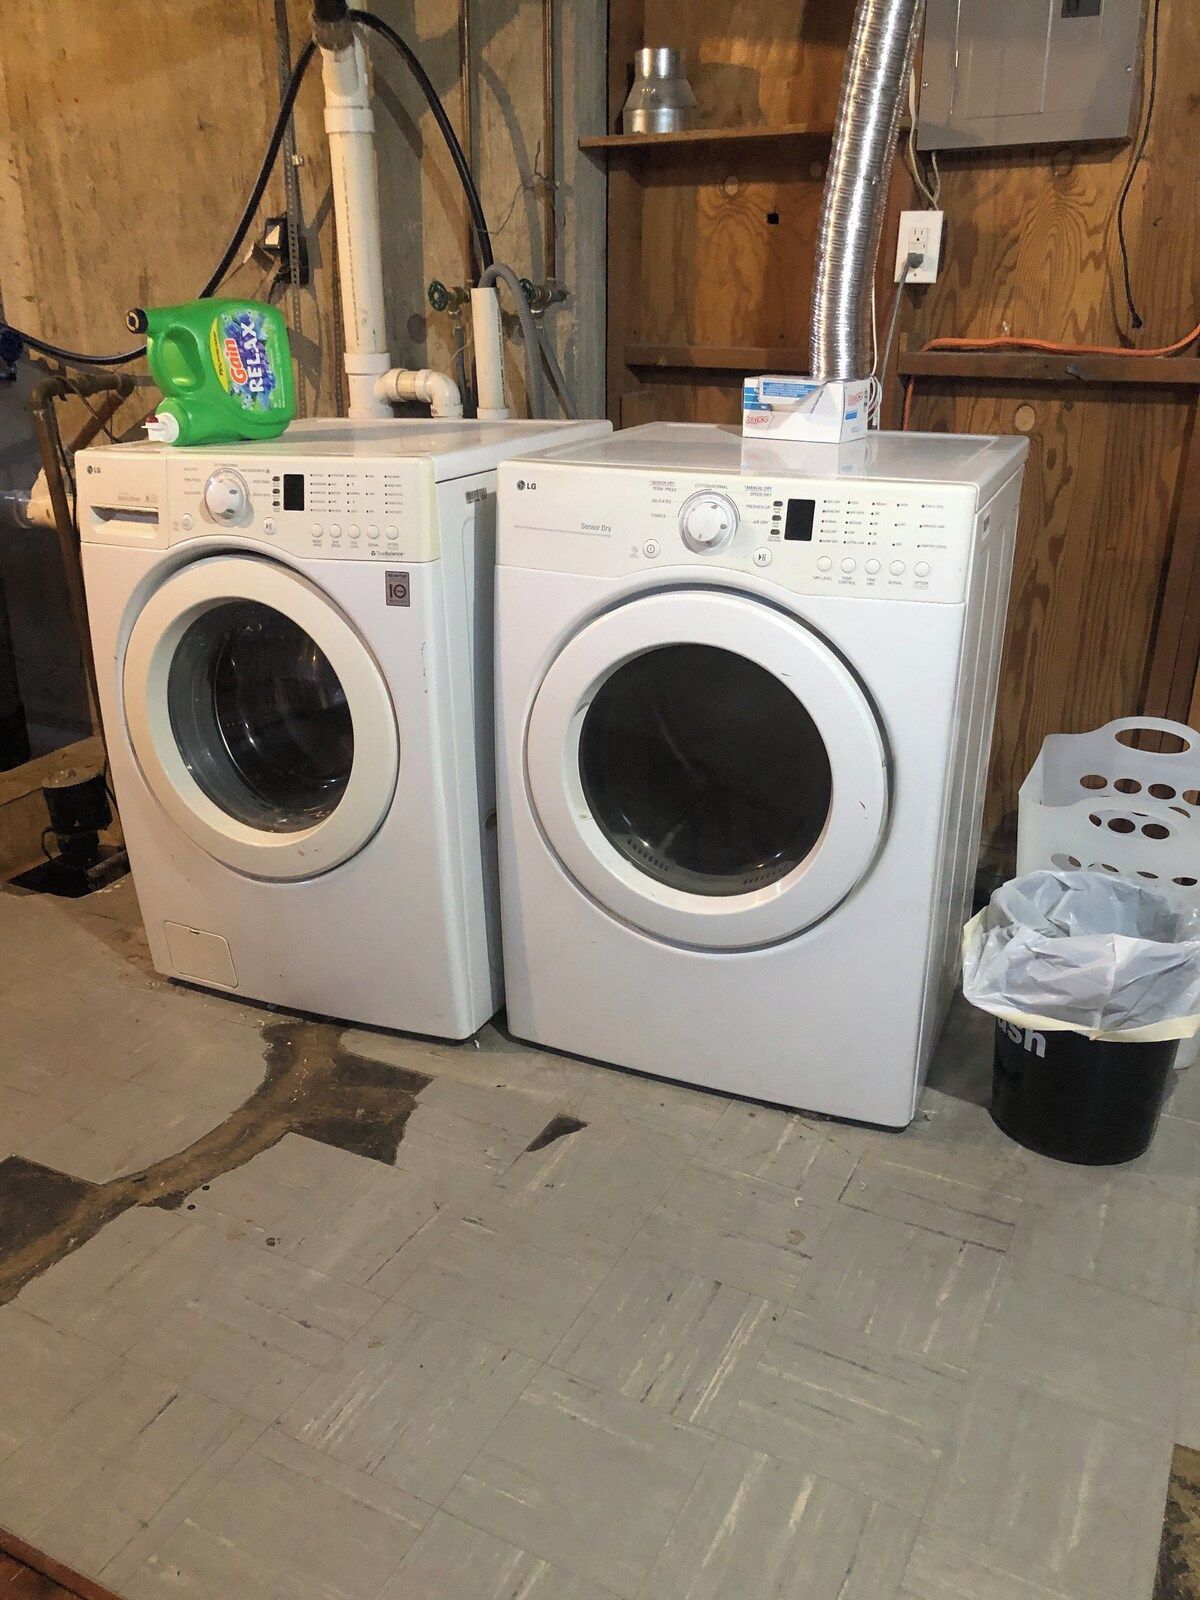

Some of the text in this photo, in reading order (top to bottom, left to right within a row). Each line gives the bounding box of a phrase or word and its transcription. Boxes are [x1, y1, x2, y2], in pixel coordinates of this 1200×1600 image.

[224, 338, 248, 385] Gain
[241, 322, 264, 393] RELAX
[580, 523, 612, 533] Sensor Dry
